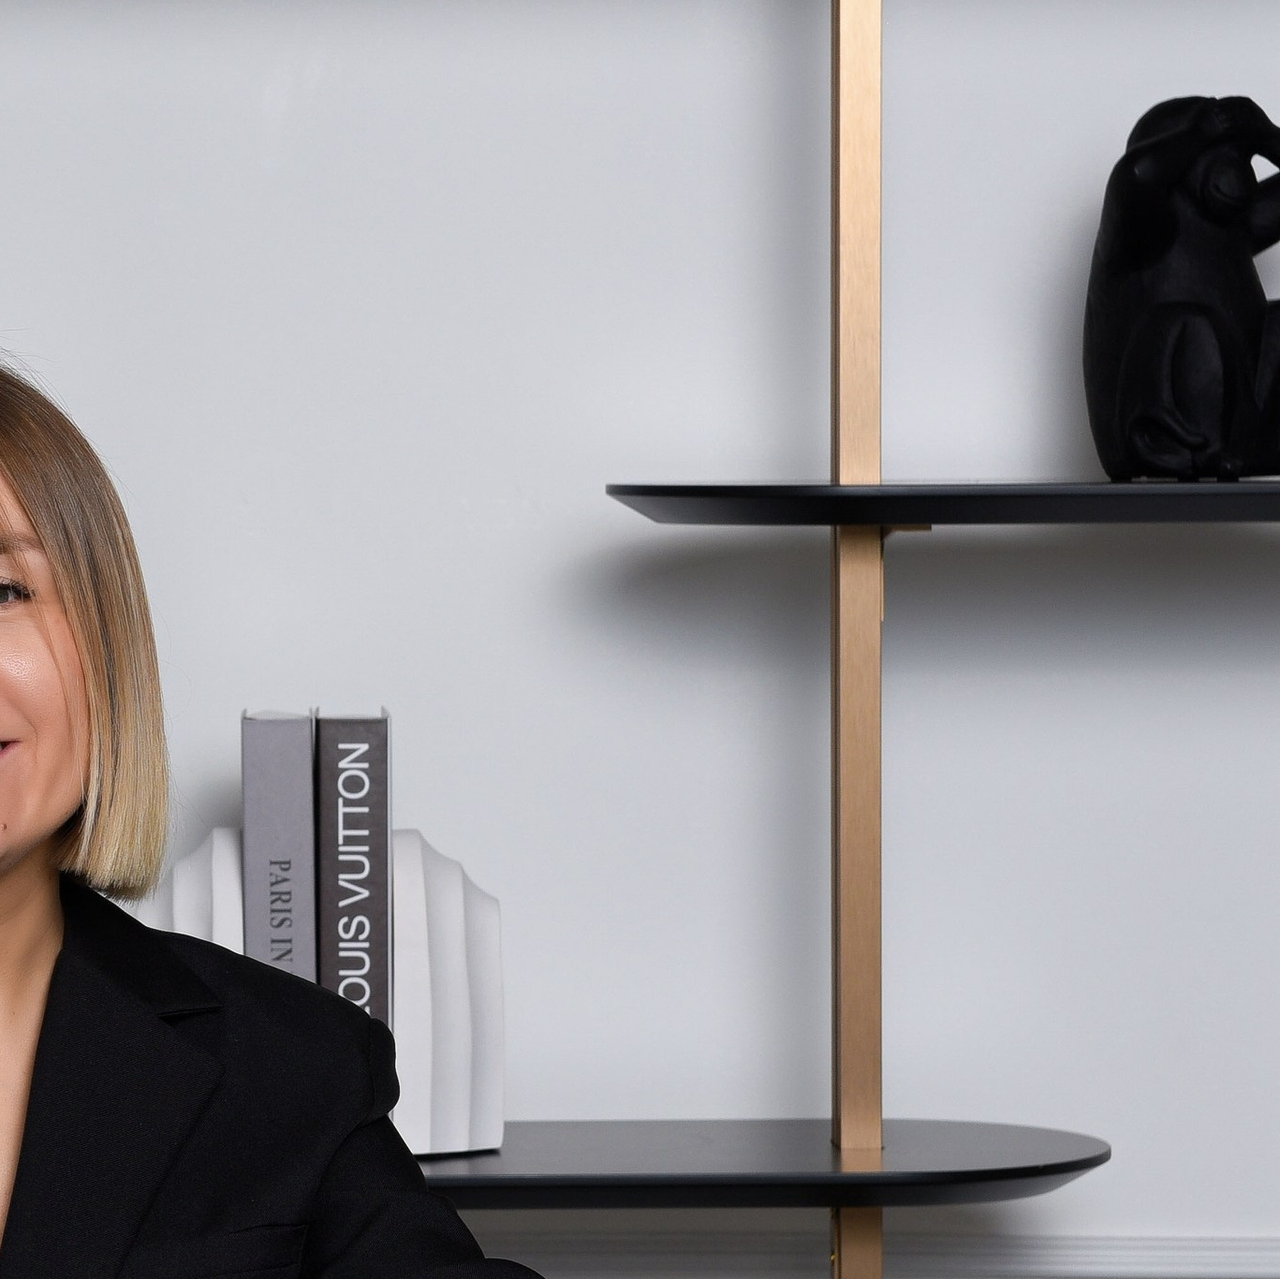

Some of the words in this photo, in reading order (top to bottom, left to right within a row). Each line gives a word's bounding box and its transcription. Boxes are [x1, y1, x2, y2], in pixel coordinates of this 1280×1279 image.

[337, 742, 371, 908] VUITTON
[269, 858, 293, 929] PARIS
[270, 937, 294, 963] IN
[337, 915, 371, 1017] OUIS
